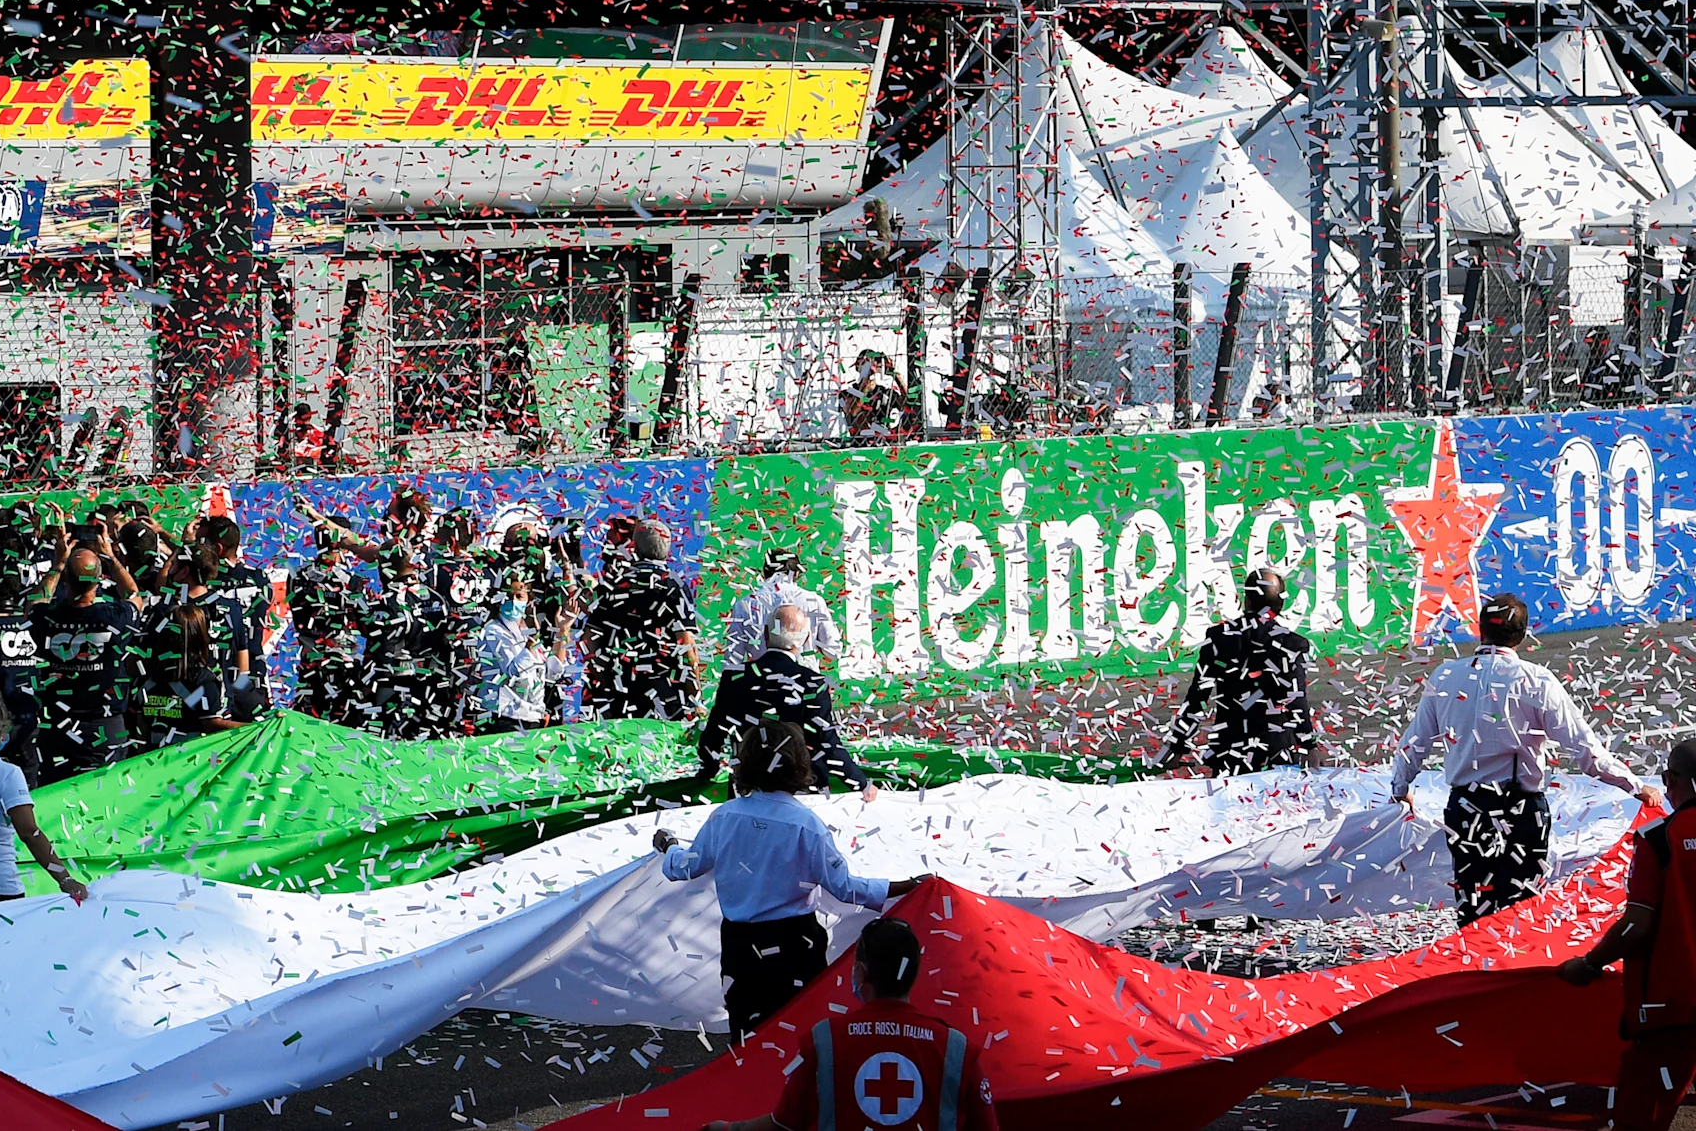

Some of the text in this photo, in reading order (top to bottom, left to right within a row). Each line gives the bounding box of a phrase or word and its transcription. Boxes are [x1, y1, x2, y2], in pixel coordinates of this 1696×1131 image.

[406, 76, 553, 127] DHL
[610, 79, 743, 127] DHL
[833, 460, 1374, 680] Heineken
[848, 1022, 935, 1041] CROCE ROSSA ITALIANA
